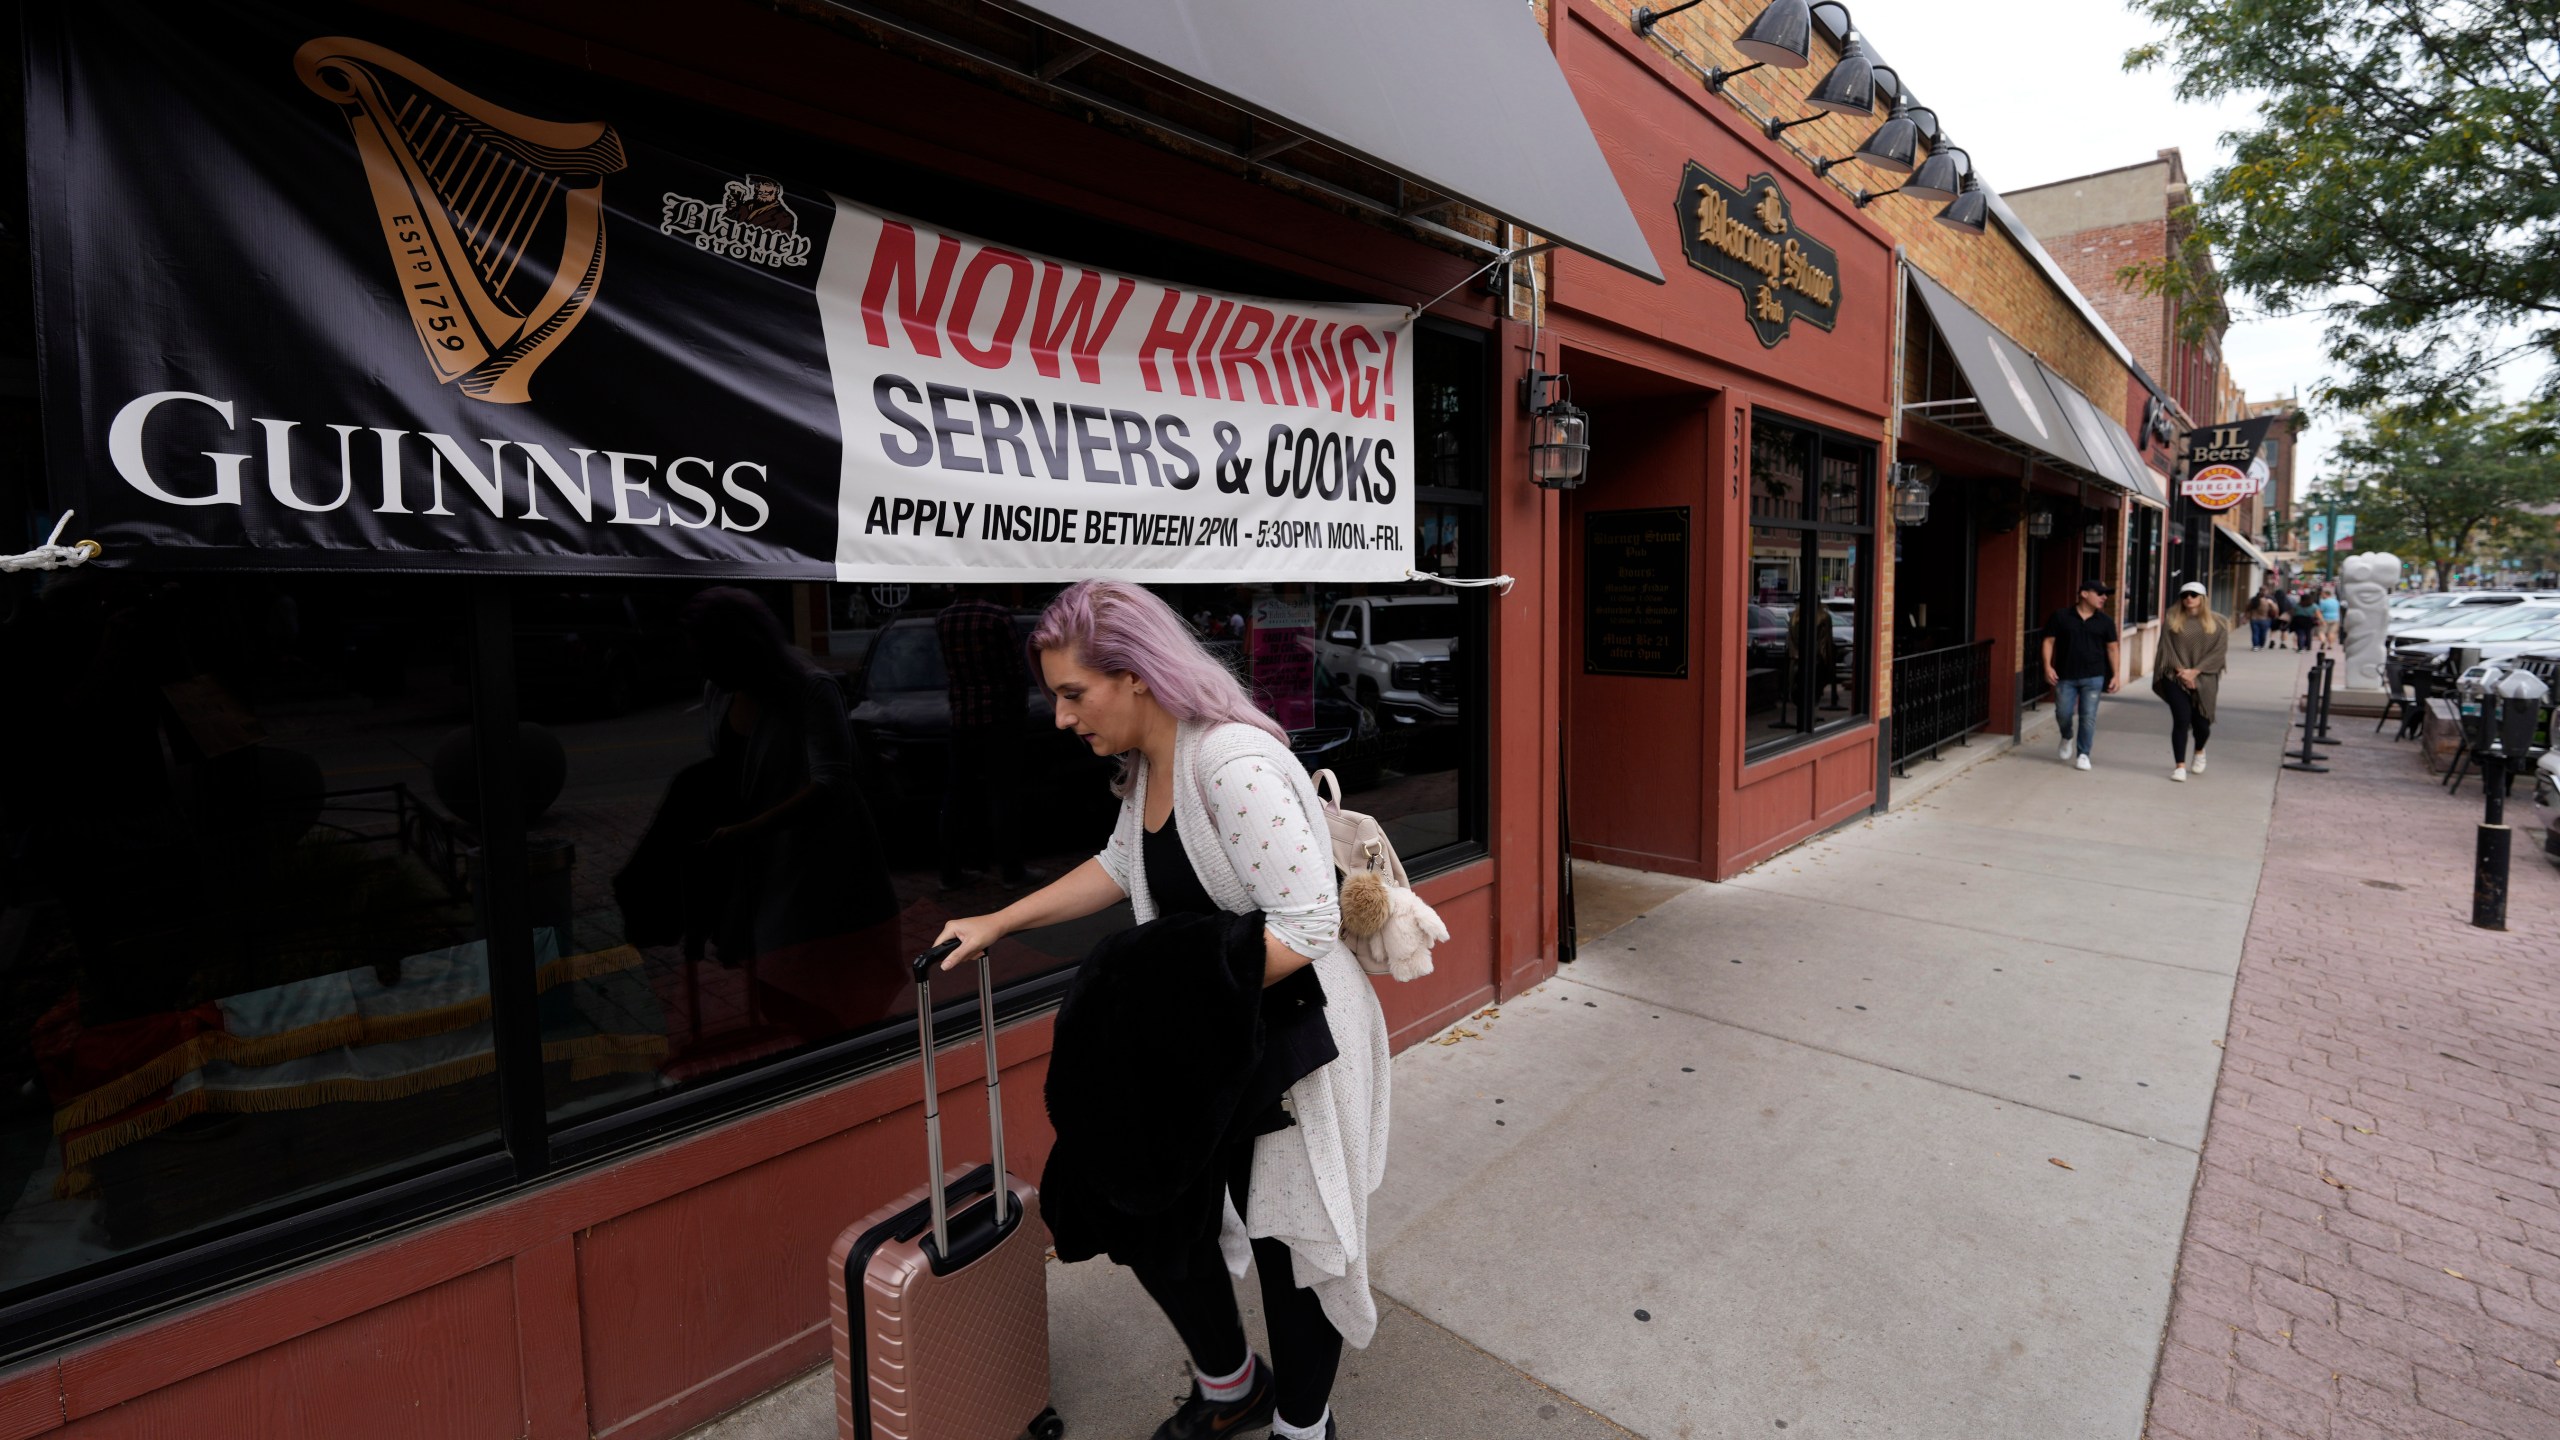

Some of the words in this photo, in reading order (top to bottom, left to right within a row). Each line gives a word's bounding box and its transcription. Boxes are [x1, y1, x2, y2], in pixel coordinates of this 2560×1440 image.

[661, 191, 811, 266] Blarney
[1696, 183, 1782, 291] Blarney
[1782, 237, 1835, 308] Stone
[696, 233, 782, 268] STONE
[413, 281, 465, 354] 1759
[861, 219, 1136, 385] NOW
[1138, 287, 1398, 421] HIRING!
[1756, 284, 1785, 325] Pub
[873, 373, 1200, 490] SERVERS
[1215, 420, 1252, 495] &
[1264, 423, 1397, 505] COOKS
[2193, 446, 2251, 462] Beers
[2209, 427, 2249, 449] JL
[2186, 482, 2251, 492] BURGERS
[865, 497, 973, 540] APPLY
[982, 503, 1078, 544] INSIDE
[1084, 510, 1195, 547] BETWEEN
[1195, 516, 1239, 547] 2PM
[1327, 521, 1404, 551] MON.-FRI.
[1594, 532, 1640, 545] Blarney
[1644, 530, 1682, 543] Stone
[1625, 546, 1647, 558] Pub
